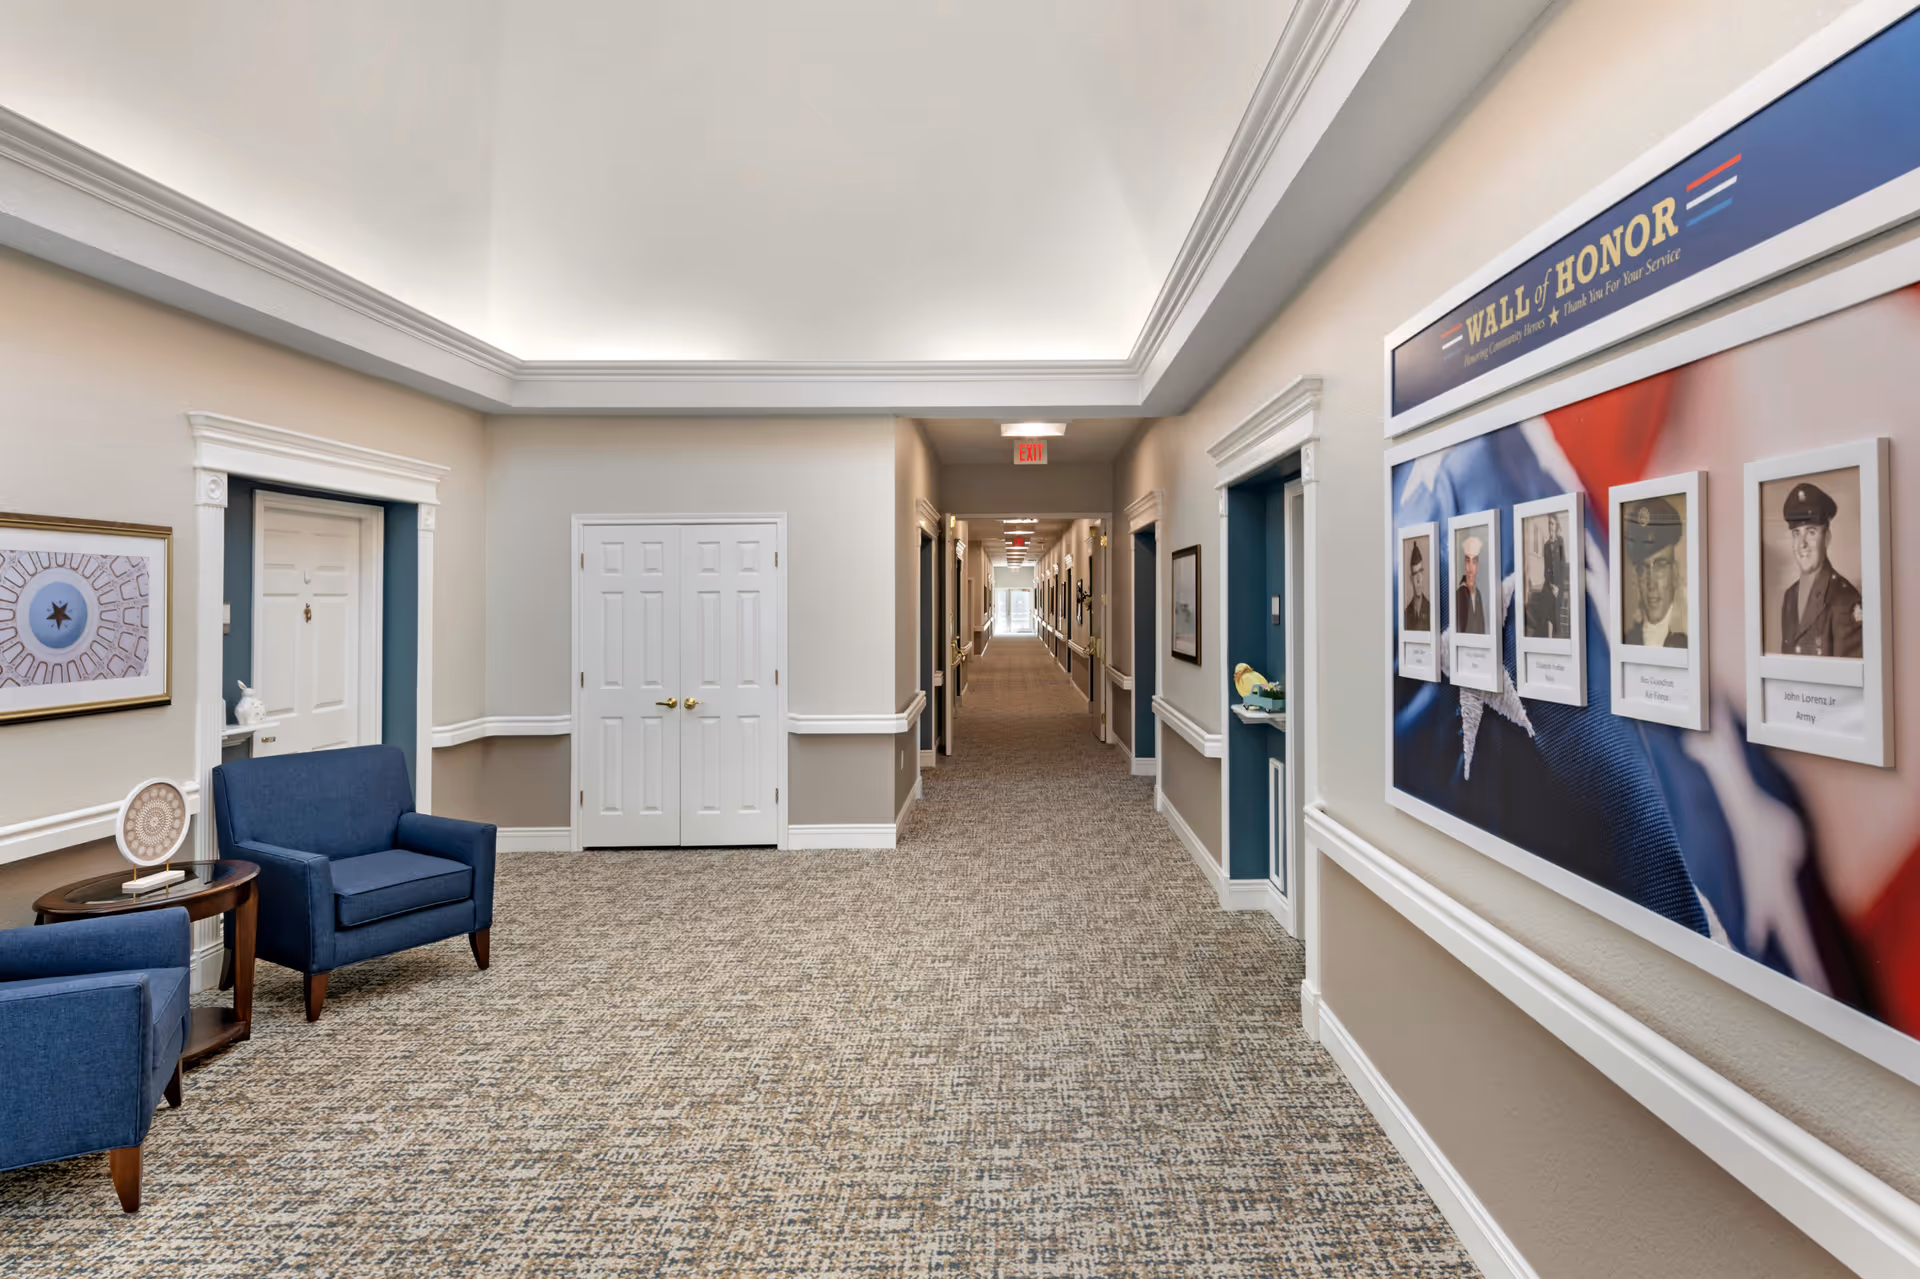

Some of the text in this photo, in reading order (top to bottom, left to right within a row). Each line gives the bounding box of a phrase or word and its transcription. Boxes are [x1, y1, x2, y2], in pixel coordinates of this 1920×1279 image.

[1465, 196, 1679, 346] WALL of HONOR
[1523, 318, 1546, 337] Heroes
[1563, 293, 1587, 317] Thank
[1588, 287, 1604, 304] You
[1605, 278, 1621, 296] For
[1622, 266, 1645, 286] Your
[1644, 248, 1681, 275] Service
[1019, 443, 1043, 461] EXIT
[1784, 691, 1836, 706] John Lorenz Jr
[1796, 711, 1816, 725] Army
